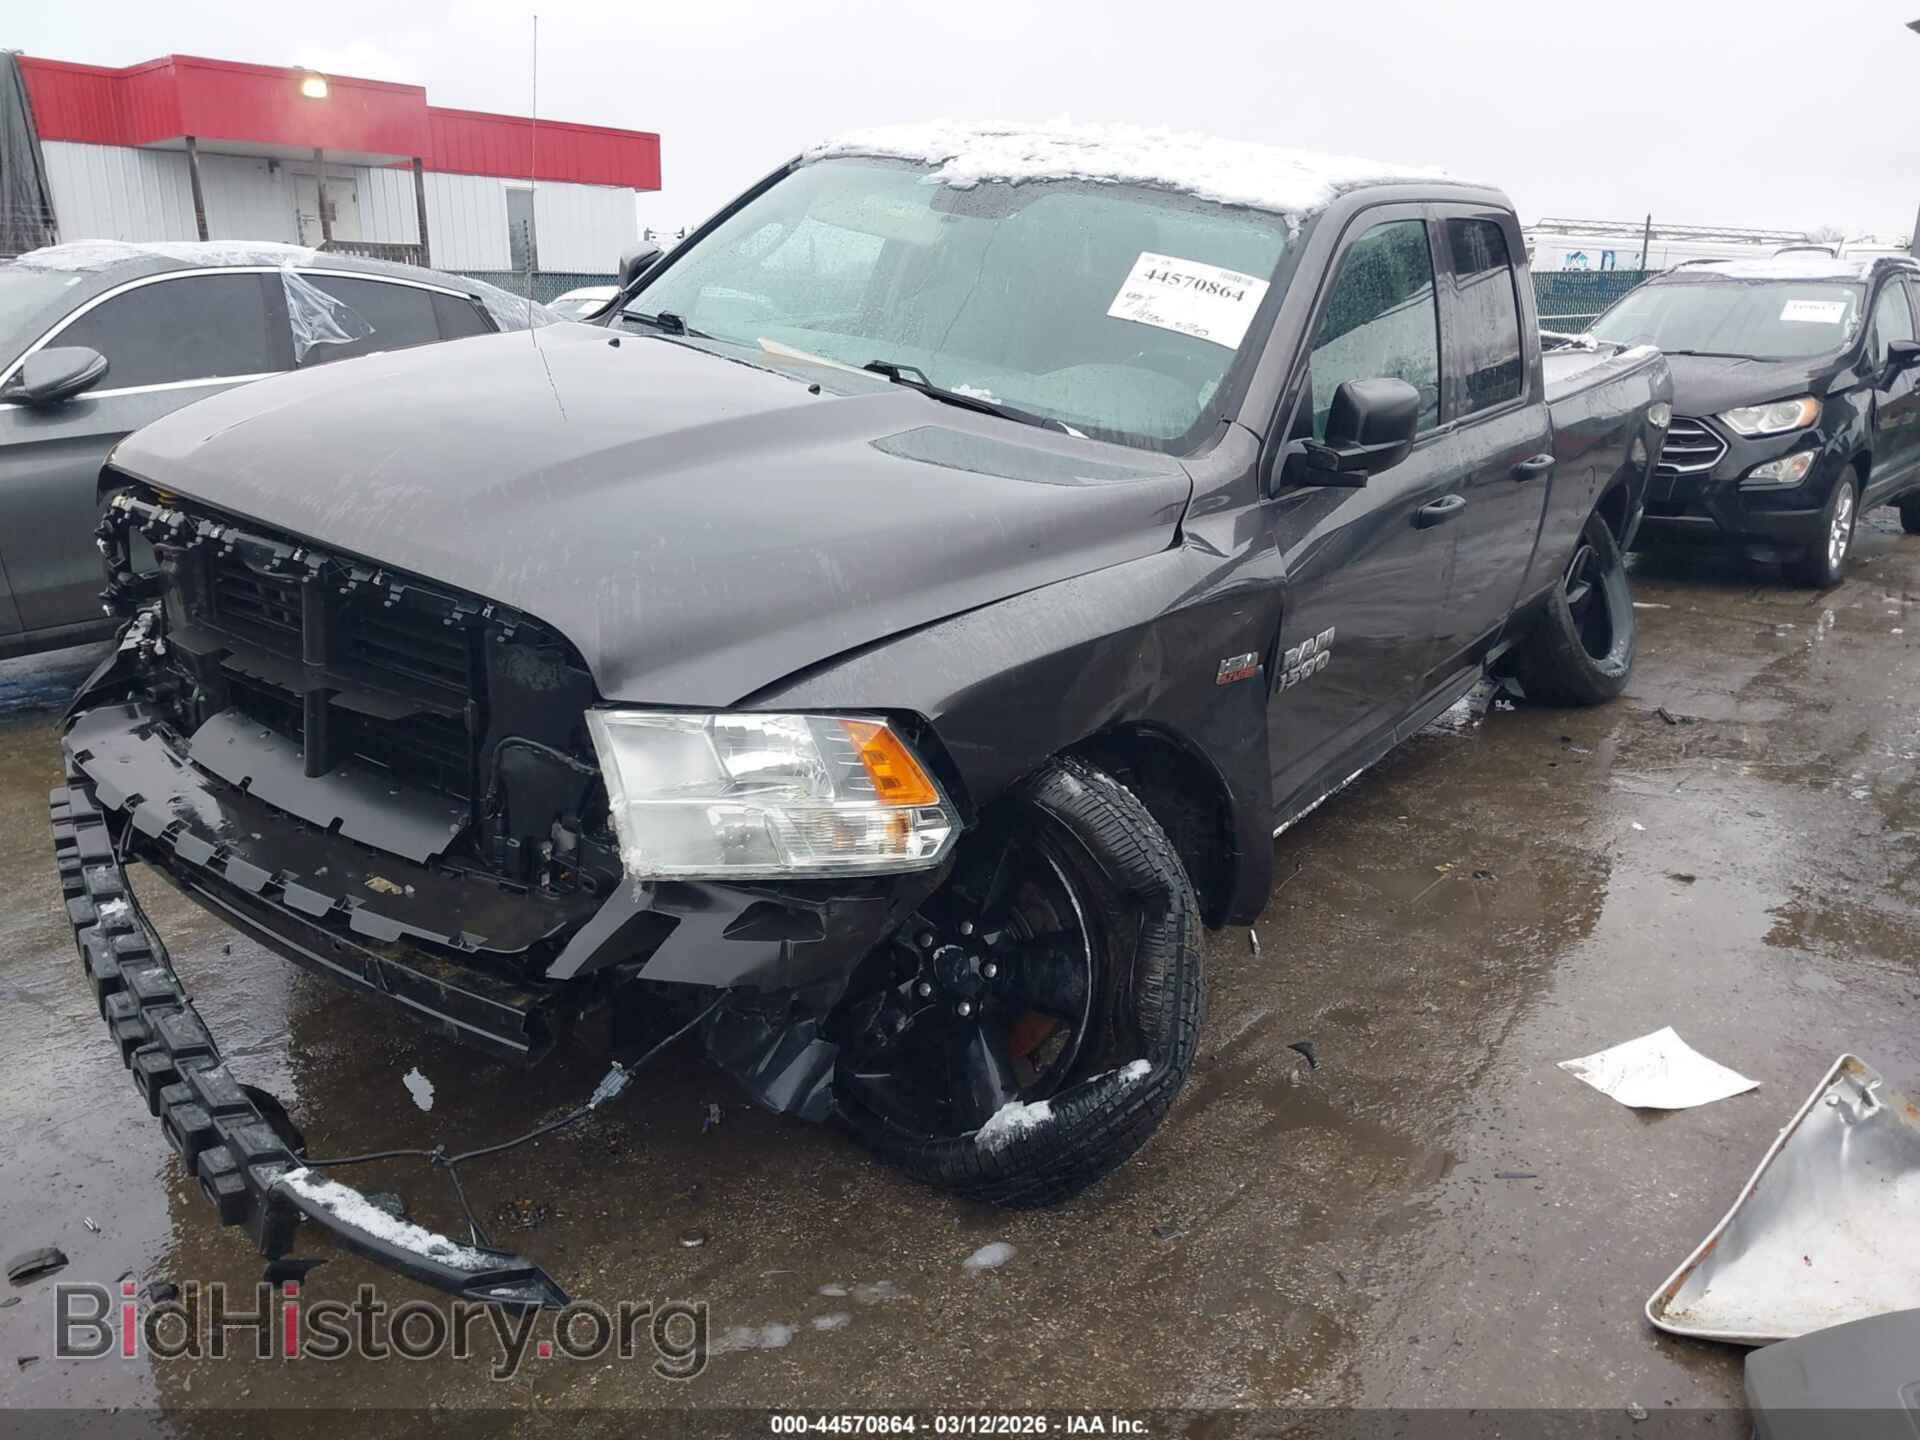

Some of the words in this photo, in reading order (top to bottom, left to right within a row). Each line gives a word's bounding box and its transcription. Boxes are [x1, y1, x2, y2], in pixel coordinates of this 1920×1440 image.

[1144, 268, 1245, 302] 44570864
[1283, 626, 1335, 673] RAM
[1279, 650, 1330, 695] 1500
